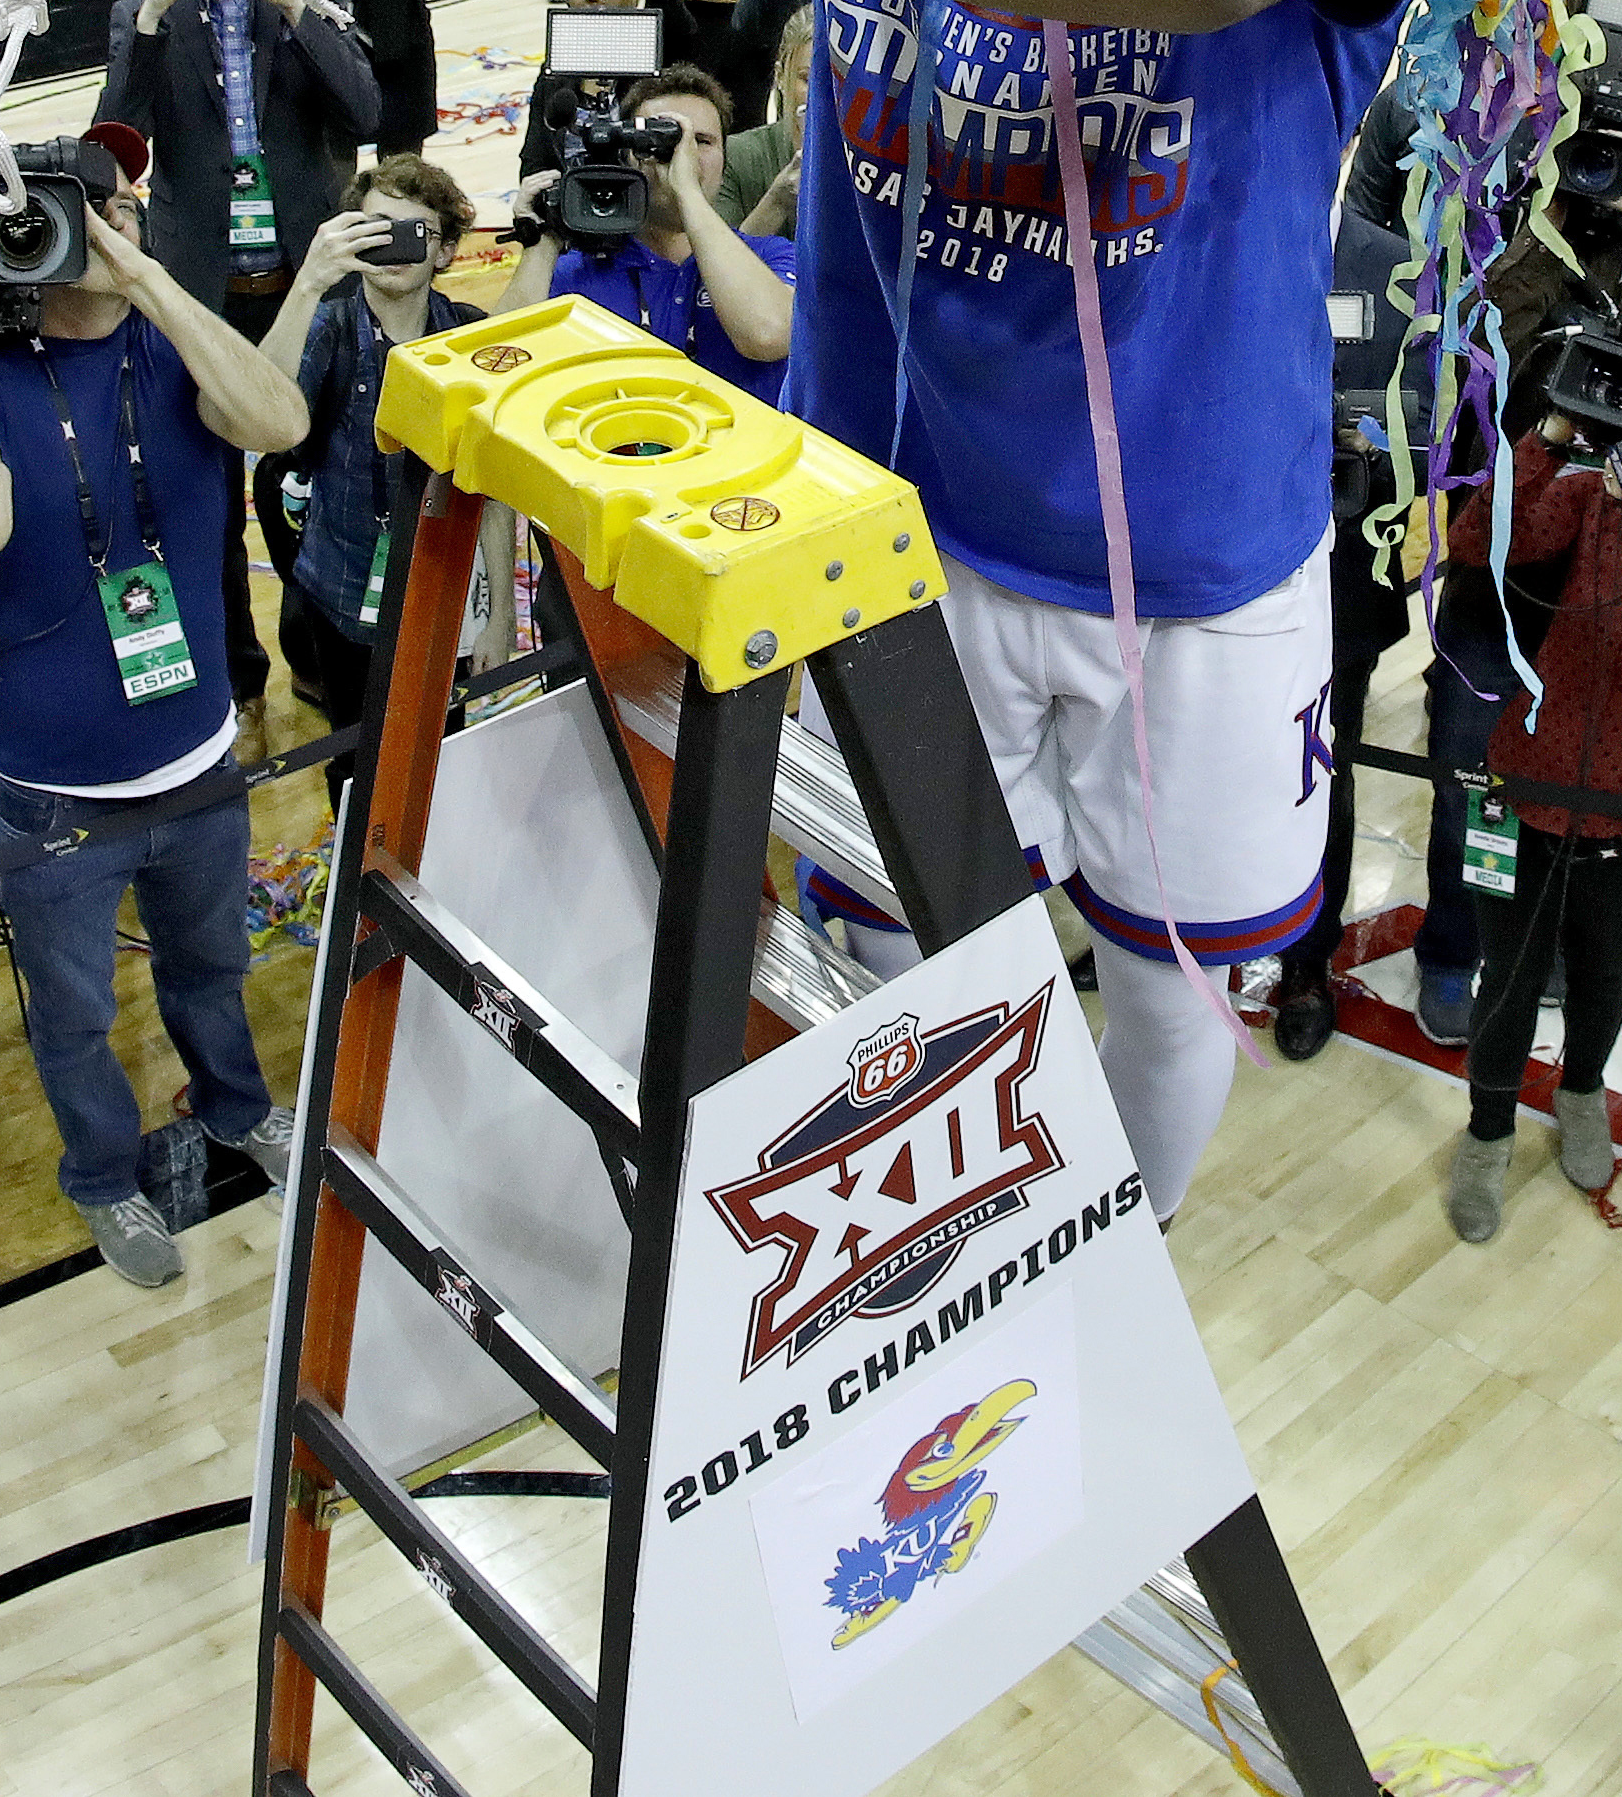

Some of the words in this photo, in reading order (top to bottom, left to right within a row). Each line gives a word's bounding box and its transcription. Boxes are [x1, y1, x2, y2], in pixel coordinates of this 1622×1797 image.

[234, 230, 264, 241] MEDIA
[915, 229, 1010, 283] 2018
[130, 664, 189, 694] ESPN
[1453, 768, 1489, 785] Sprint
[857, 1022, 910, 1063] PHILLIPS
[863, 1045, 909, 1092] 66
[729, 983, 1059, 1353] XII
[816, 1202, 1000, 1331] CHAMPIONSHIP
[664, 1403, 810, 1523] 2018
[827, 1171, 1143, 1415] CHAMPIONS
[879, 1516, 940, 1578] KU
